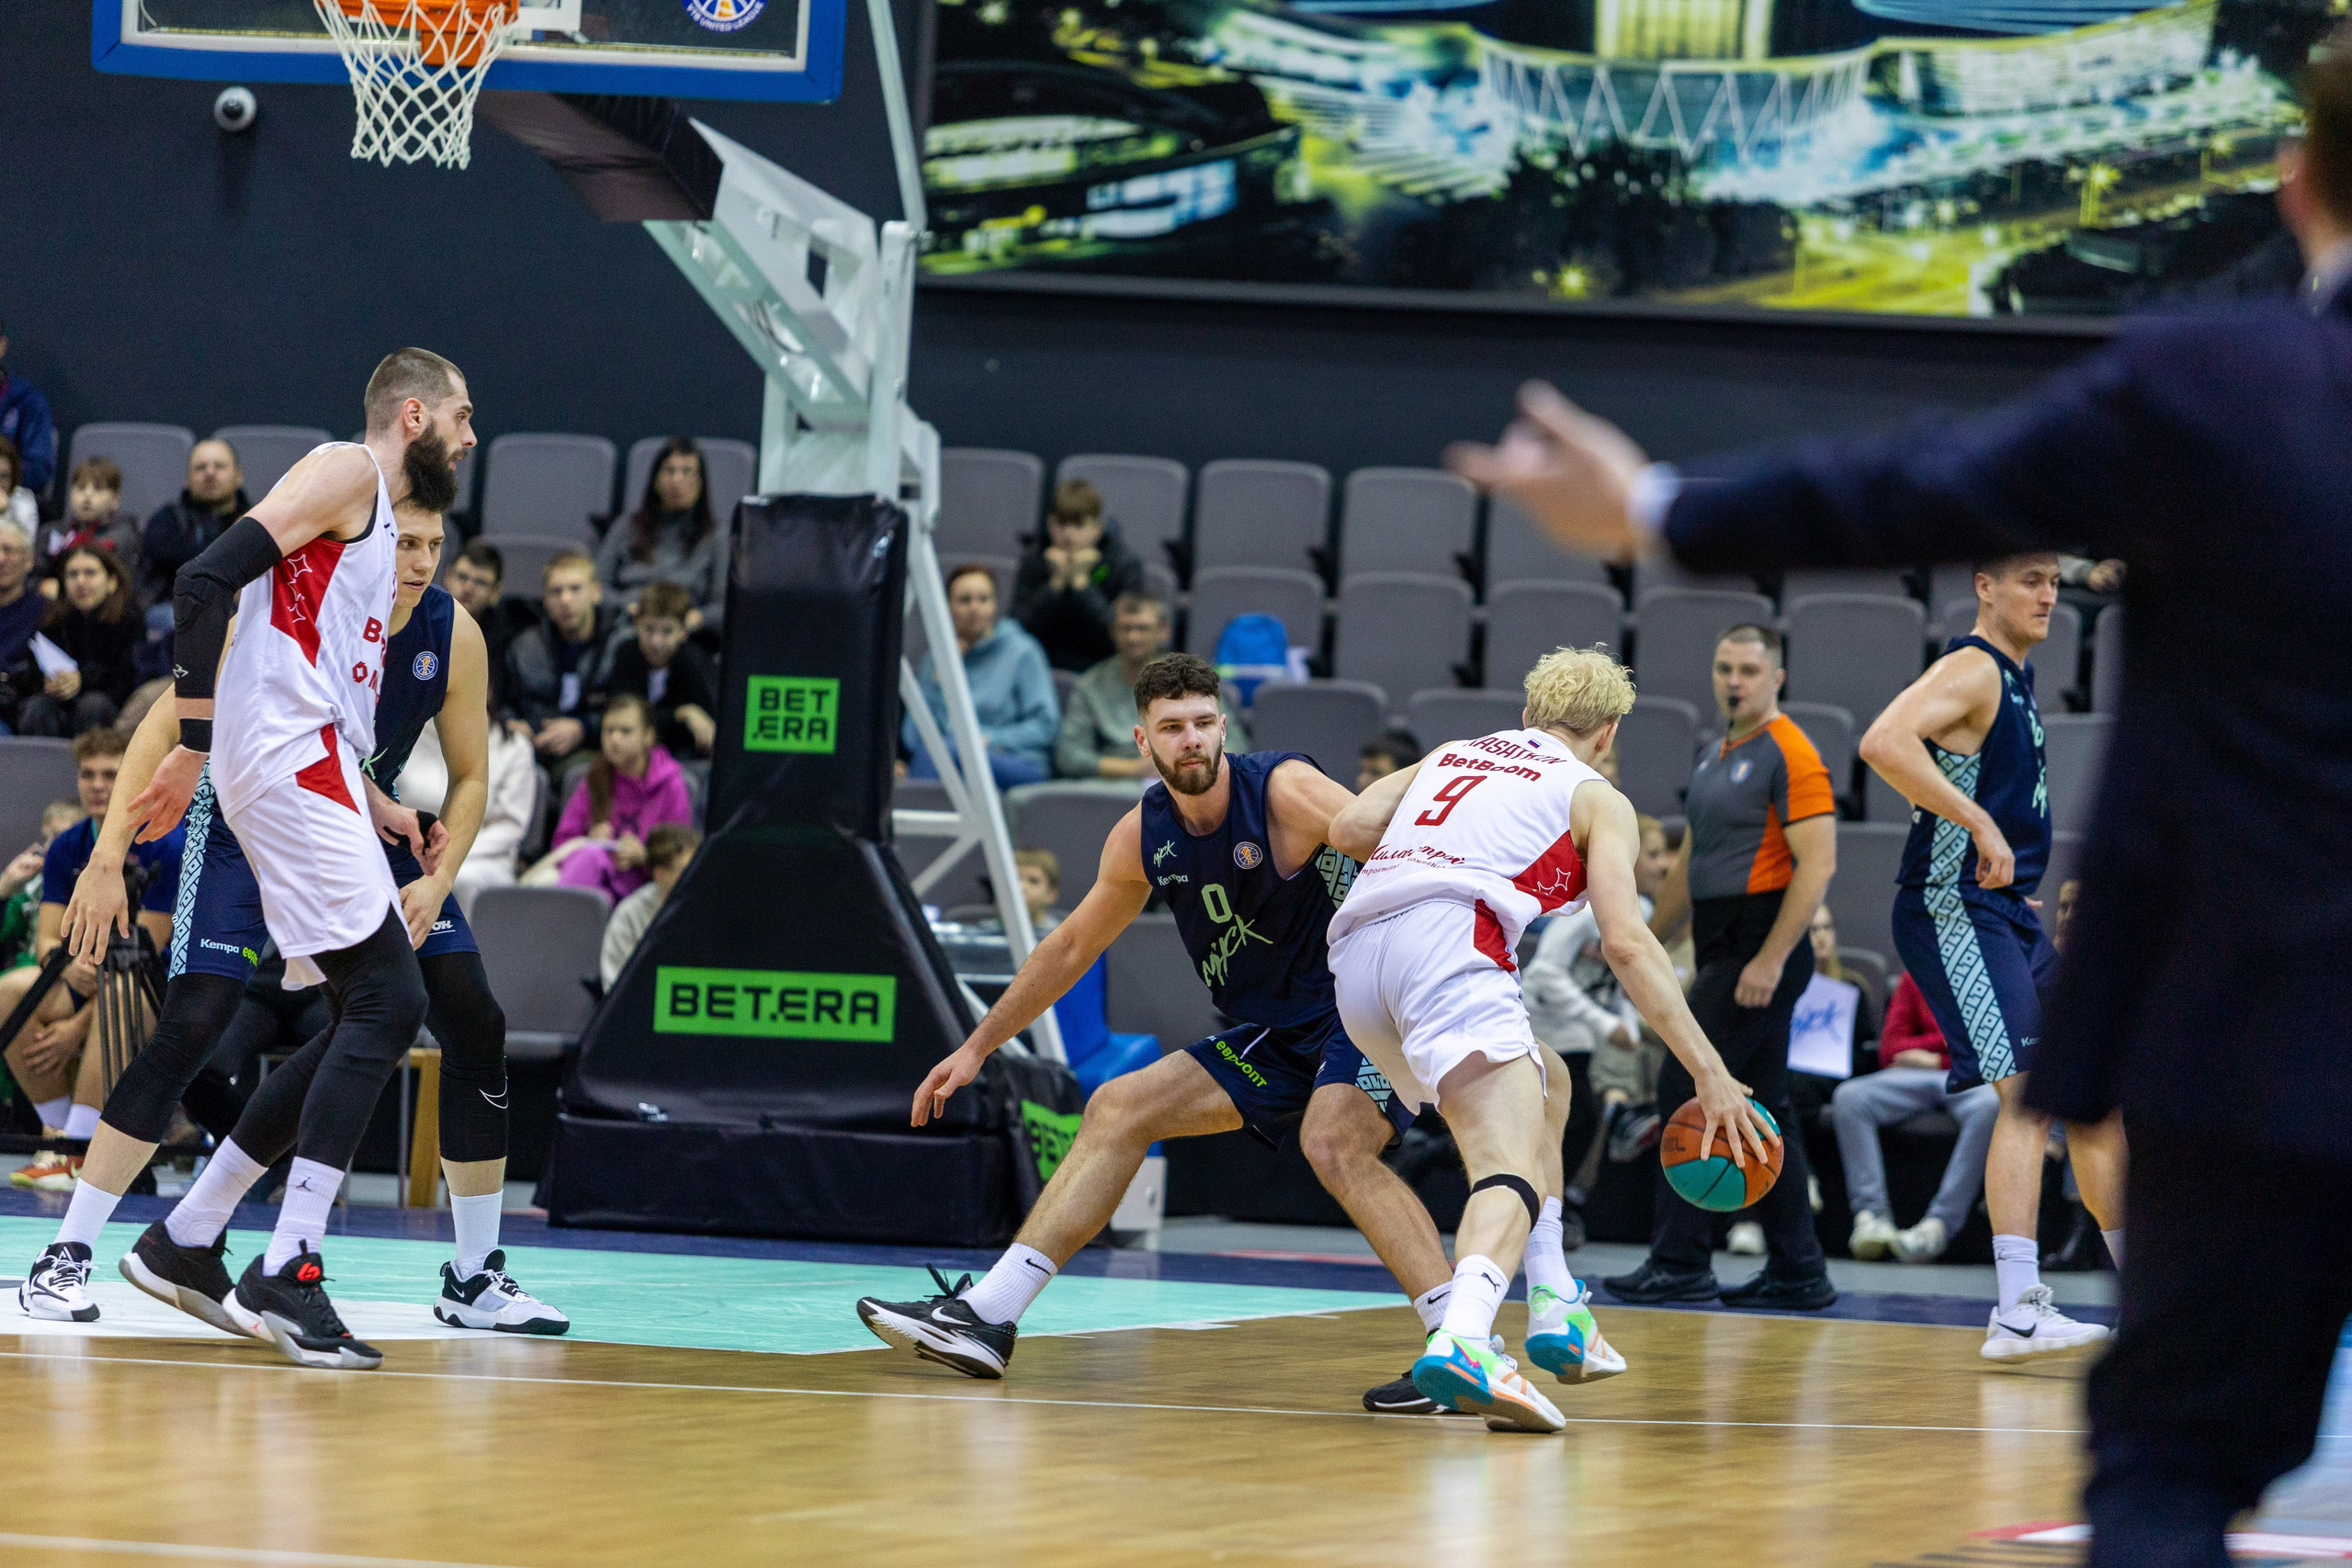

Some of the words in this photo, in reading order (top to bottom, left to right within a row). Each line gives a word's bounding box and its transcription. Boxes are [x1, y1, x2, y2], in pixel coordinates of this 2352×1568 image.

[760, 687, 830, 714] BET
[1437, 753, 1542, 782] BetBoom
[1414, 775, 1487, 826] 9
[1157, 874, 1189, 886] Kempa
[1201, 883, 1233, 924] 0
[200, 938, 239, 953] Kempa
[670, 983, 879, 1026] BET.ERA
